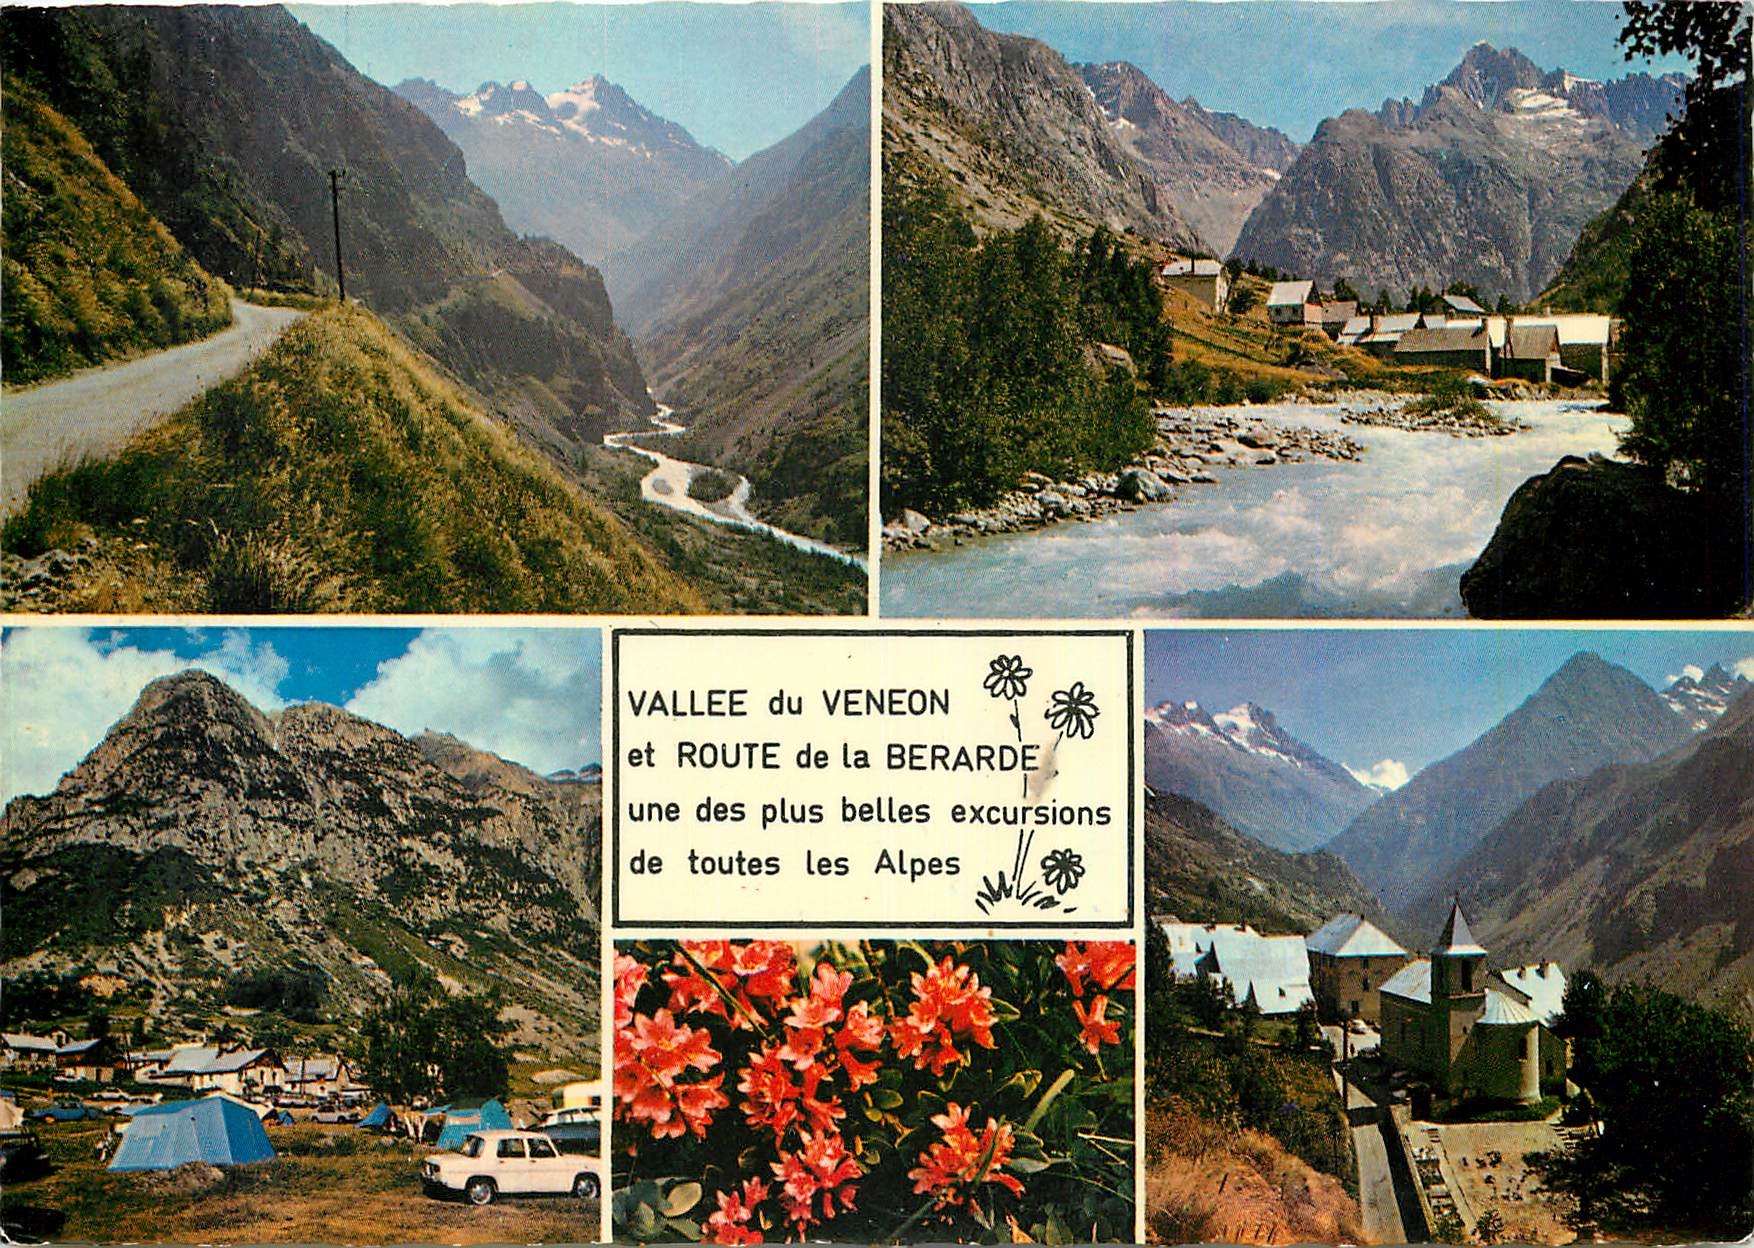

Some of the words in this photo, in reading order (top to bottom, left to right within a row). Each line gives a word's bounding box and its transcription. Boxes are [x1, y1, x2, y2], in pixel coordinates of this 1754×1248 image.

[628, 689, 748, 717] VALLEE
[768, 688, 803, 716] du
[822, 688, 949, 716] VENEON
[627, 741, 655, 768] et
[678, 741, 781, 769] ROUTE
[796, 742, 829, 769] de
[842, 742, 871, 769] la
[887, 743, 1040, 772] BERARDE
[628, 802, 681, 822] une
[696, 796, 746, 823] des
[762, 797, 824, 830] plus
[841, 796, 931, 824] belles
[951, 800, 1111, 826] excursions
[629, 849, 663, 875] de
[688, 848, 780, 876] toutes
[806, 849, 850, 876] les
[874, 848, 961, 883] Alpes
